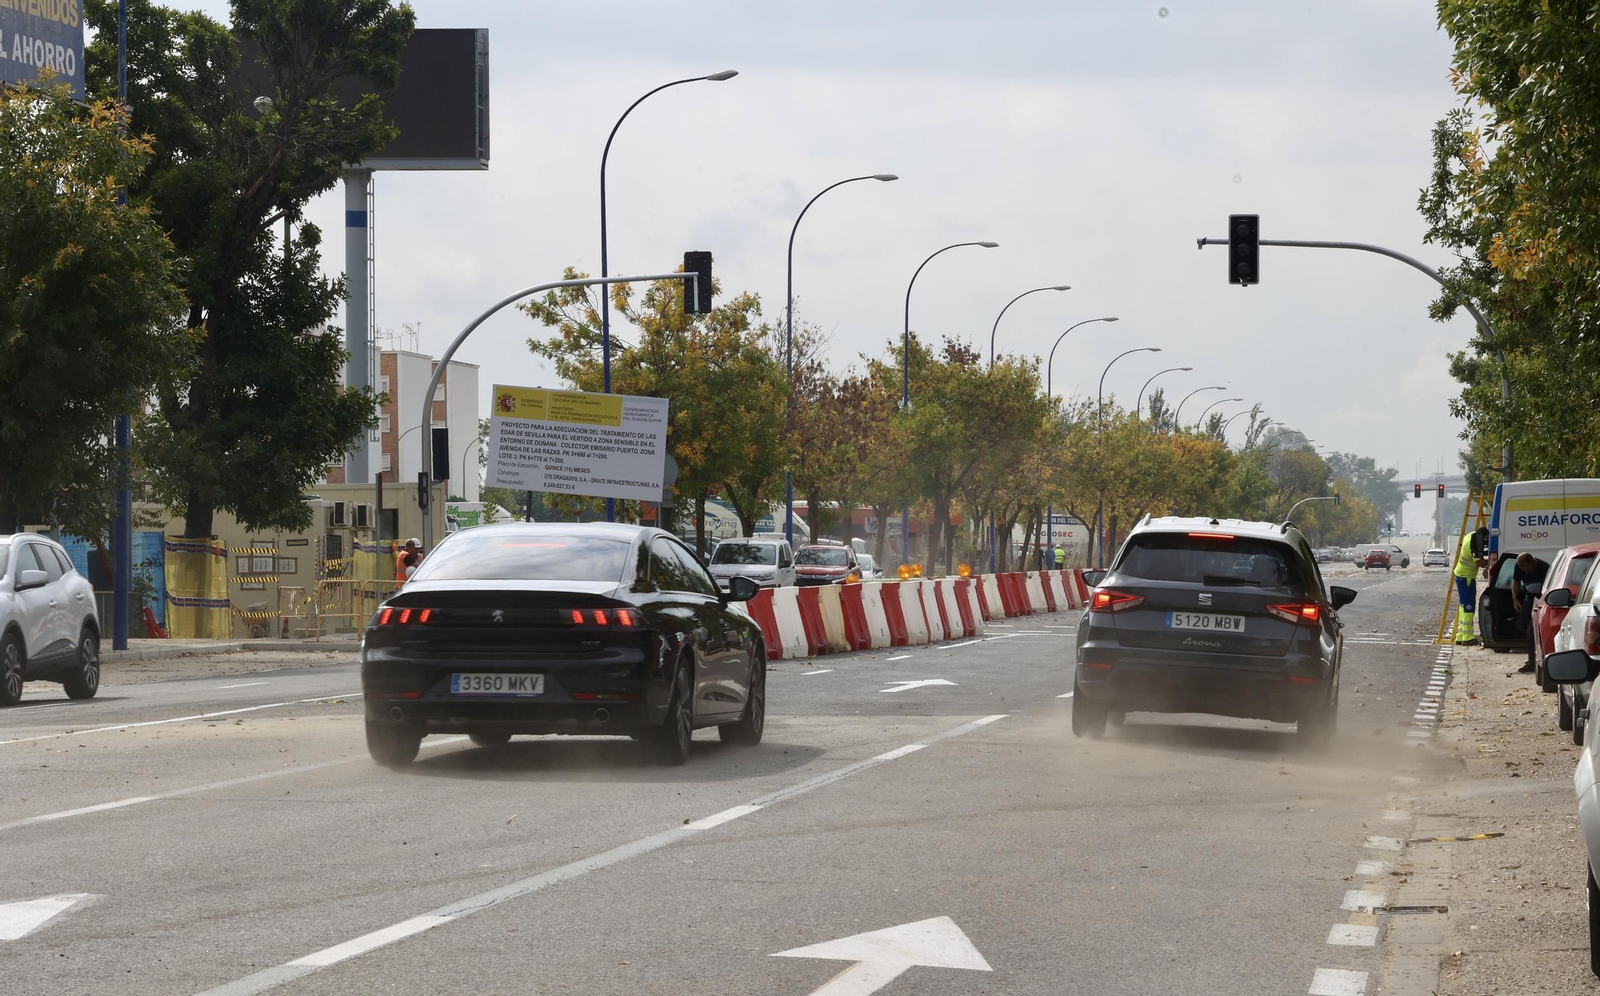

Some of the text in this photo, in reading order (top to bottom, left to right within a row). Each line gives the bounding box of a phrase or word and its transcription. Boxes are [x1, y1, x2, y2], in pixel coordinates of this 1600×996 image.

[12, 34, 76, 76] AHORRO
[600, 430, 636, 438] TRATAMIENTO
[1175, 614, 1241, 629] 5120 MBW
[462, 677, 539, 691] 3360 MKV
